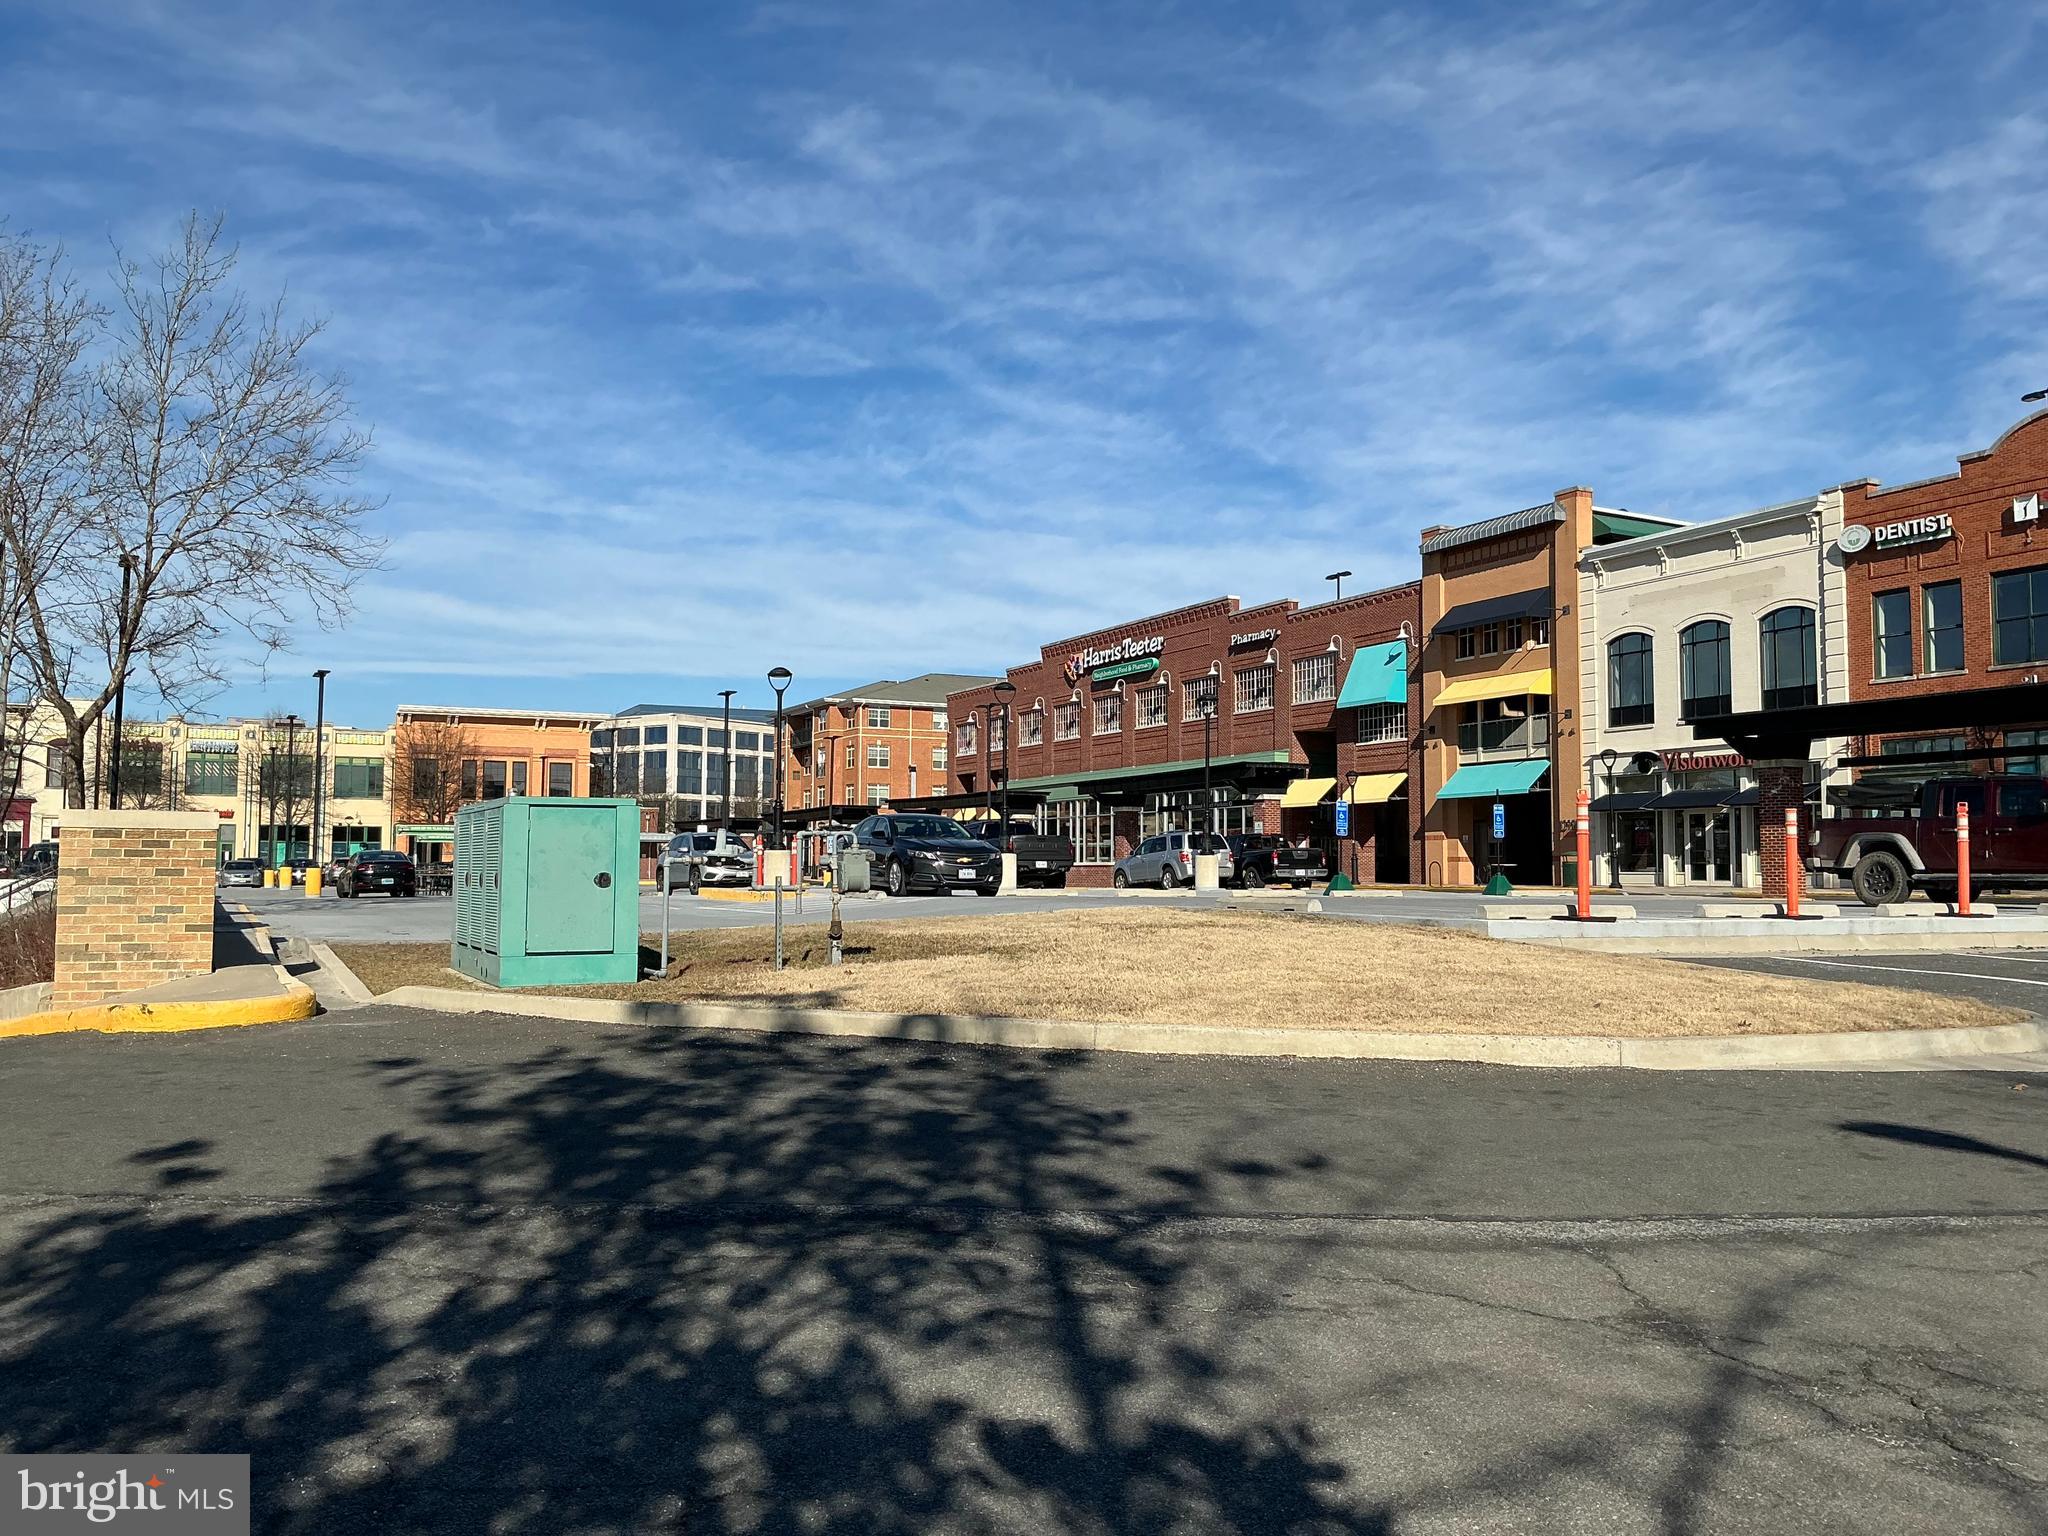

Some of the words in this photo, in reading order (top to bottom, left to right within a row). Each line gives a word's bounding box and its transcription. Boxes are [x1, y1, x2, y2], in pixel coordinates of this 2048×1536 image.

[1875, 513, 1949, 542] DENTIST
[1231, 629, 1276, 645] Pharmacy
[1083, 643, 1121, 668] Harris
[1122, 636, 1164, 658] Teeter
